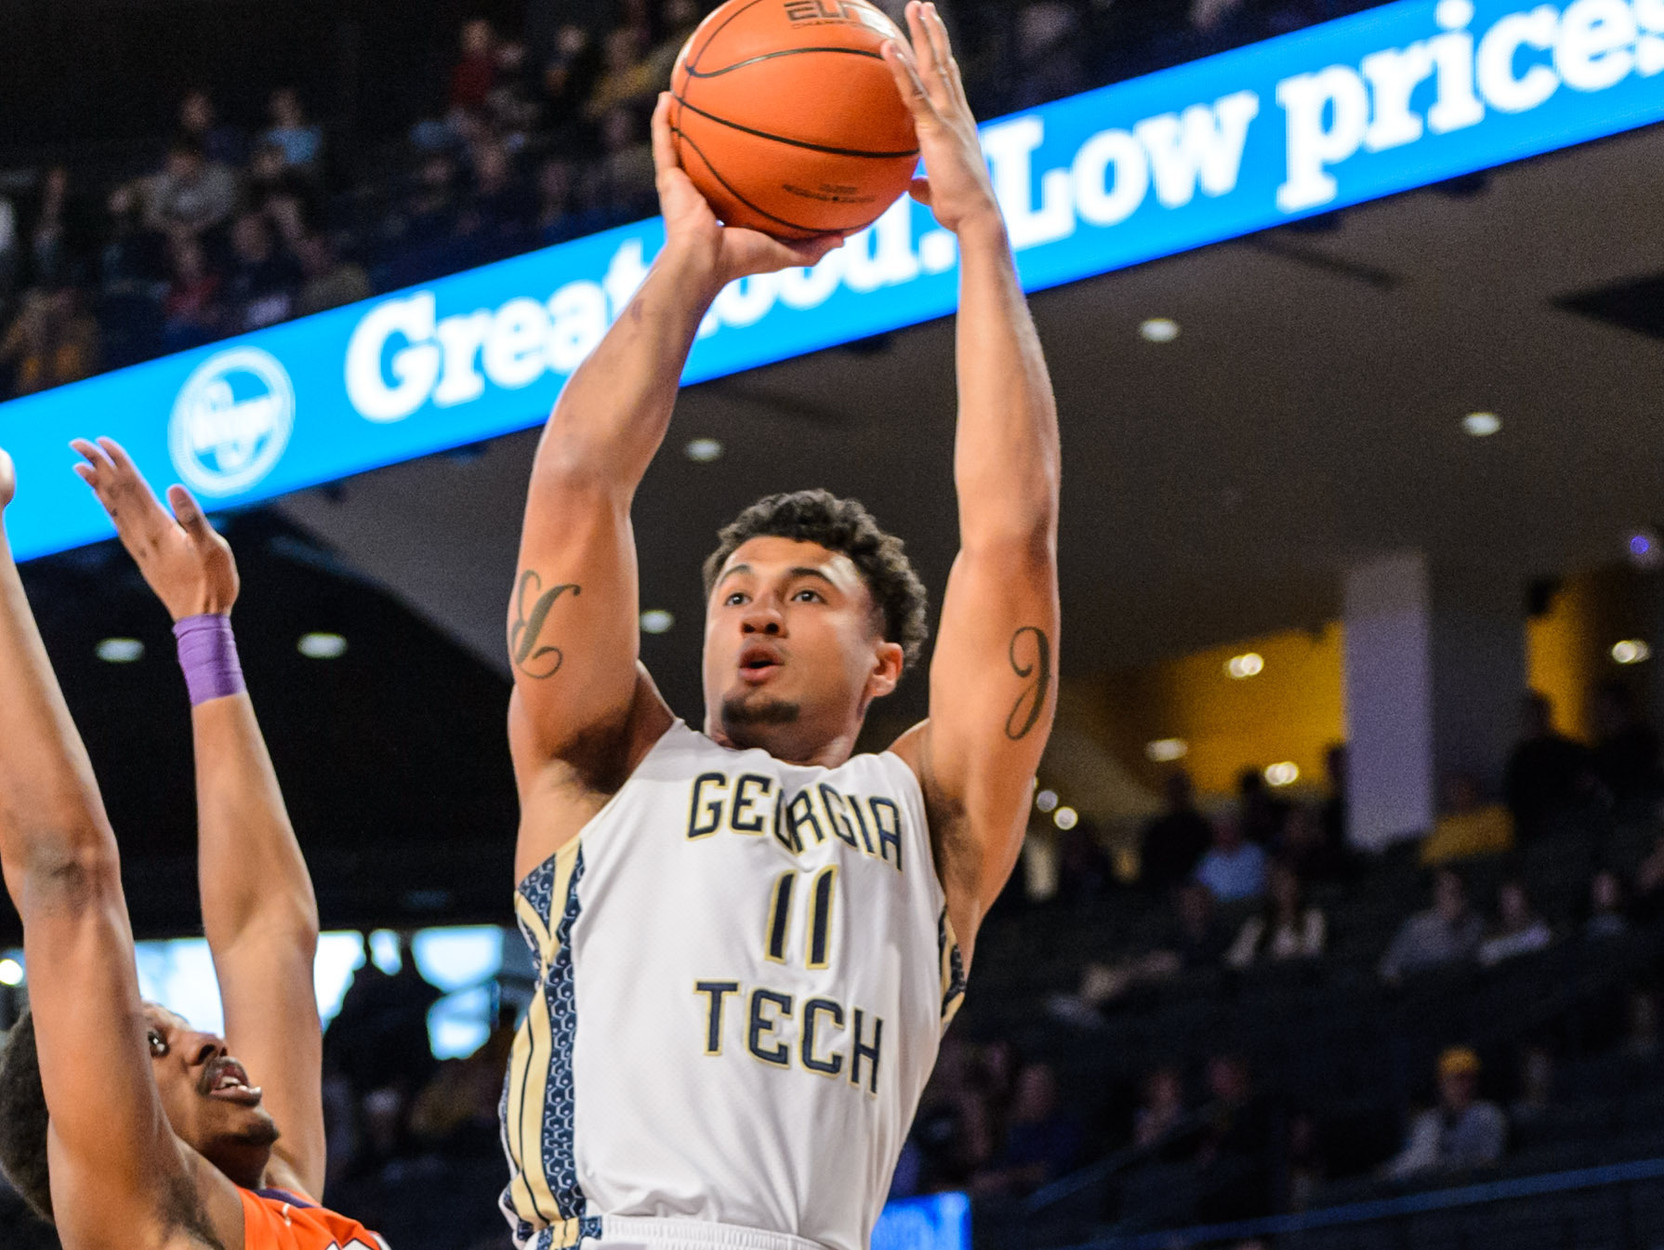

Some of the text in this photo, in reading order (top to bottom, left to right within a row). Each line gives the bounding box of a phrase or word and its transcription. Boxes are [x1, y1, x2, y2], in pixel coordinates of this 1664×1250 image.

[977, 88, 1260, 252] Low
[685, 769, 905, 875] GEORGIA
[764, 863, 839, 970] 11
[693, 978, 884, 1098] TECH
